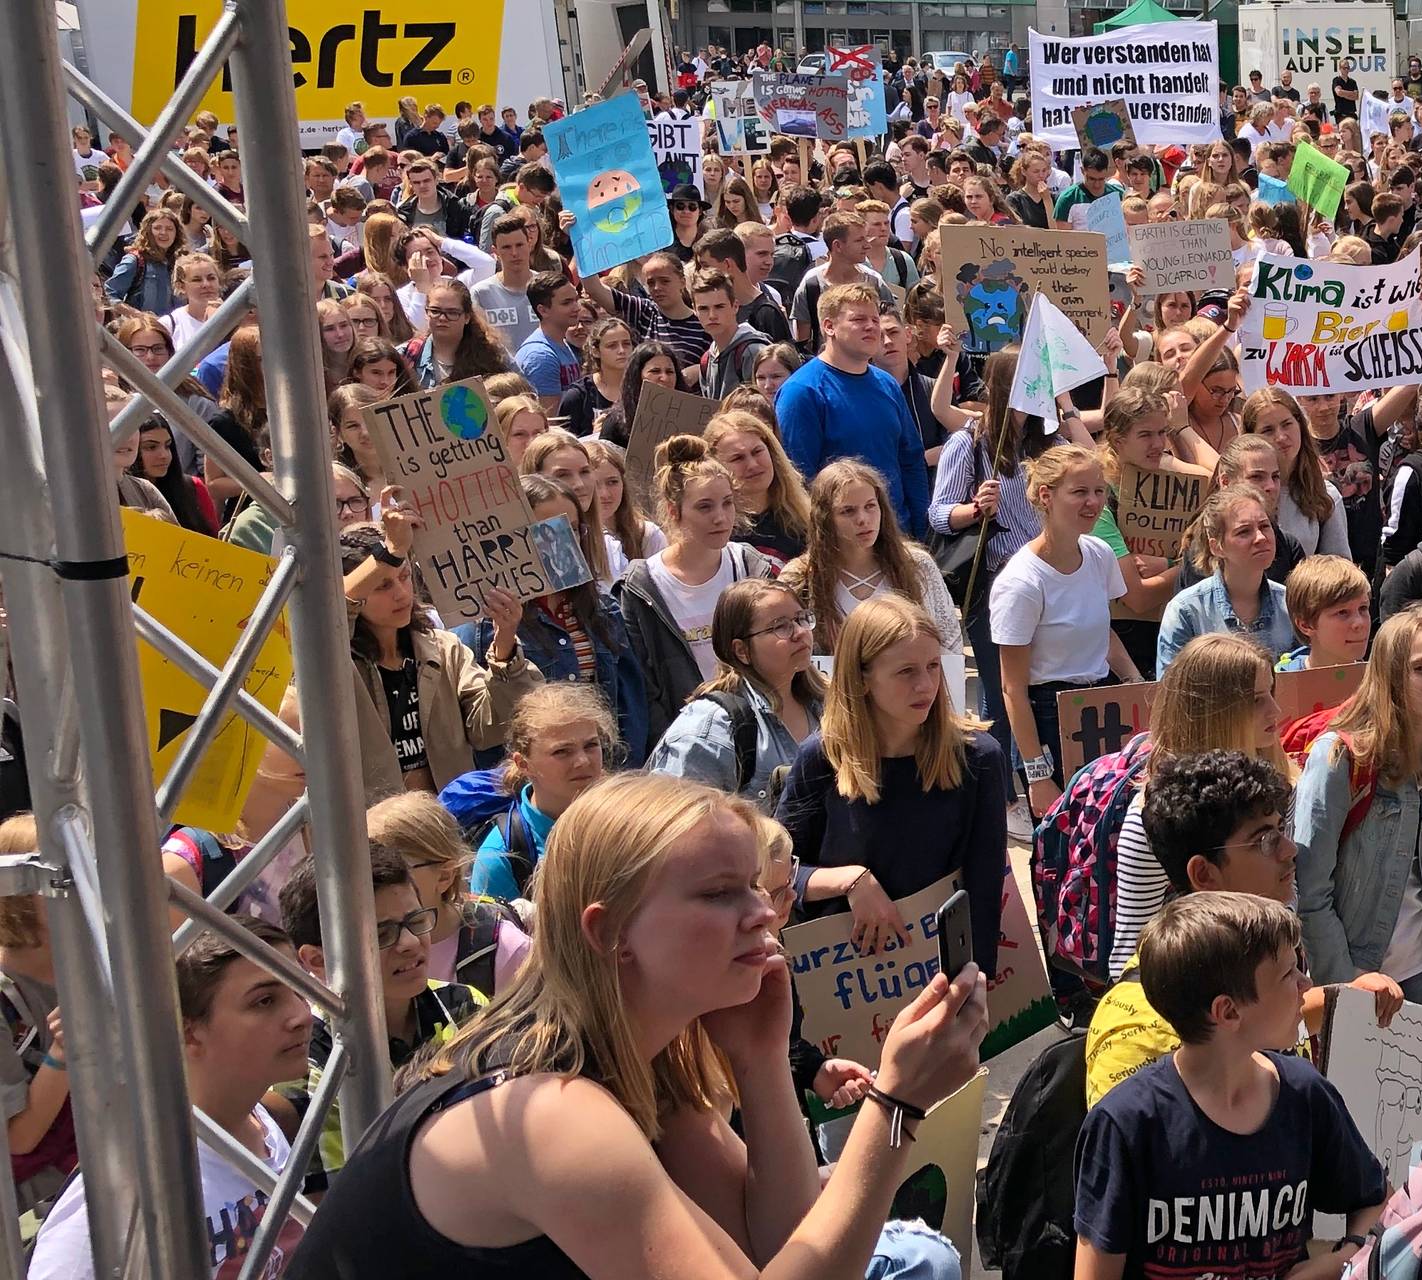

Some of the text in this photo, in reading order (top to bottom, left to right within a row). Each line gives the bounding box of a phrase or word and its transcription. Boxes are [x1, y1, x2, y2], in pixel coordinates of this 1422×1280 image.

[1043, 42, 1212, 64] Wer verstanden hat
[1282, 27, 1386, 55] INSEL
[1286, 56, 1387, 73] AUF TOUR
[761, 84, 773, 96] IS
[779, 73, 826, 85] PLANET
[1053, 72, 1209, 96] und nicht handelt
[818, 106, 845, 136] ASS
[1042, 105, 1070, 128] hat
[1135, 227, 1166, 241] EARTH
[1170, 225, 1180, 237] IS
[1182, 223, 1223, 236] GETTING
[1180, 239, 1208, 249] THAN
[979, 237, 1099, 263] No intelligent species
[1142, 250, 1232, 271] YOUNG LEONARDO
[1030, 263, 1092, 277] would destroy
[1052, 281, 1078, 293] their
[1253, 261, 1386, 309] Klima ist
[1061, 296, 1084, 305] own
[1311, 311, 1380, 344] Bier
[1266, 342, 1330, 388] WARM
[1329, 344, 1344, 356] ist
[644, 389, 684, 418] ICH
[375, 396, 445, 452] THE
[397, 434, 505, 478] is getting
[412, 464, 522, 531] HOTTER
[1134, 472, 1200, 512] KLIMA
[453, 515, 501, 544] than
[169, 541, 244, 593] keinen
[432, 527, 532, 589] HARRY
